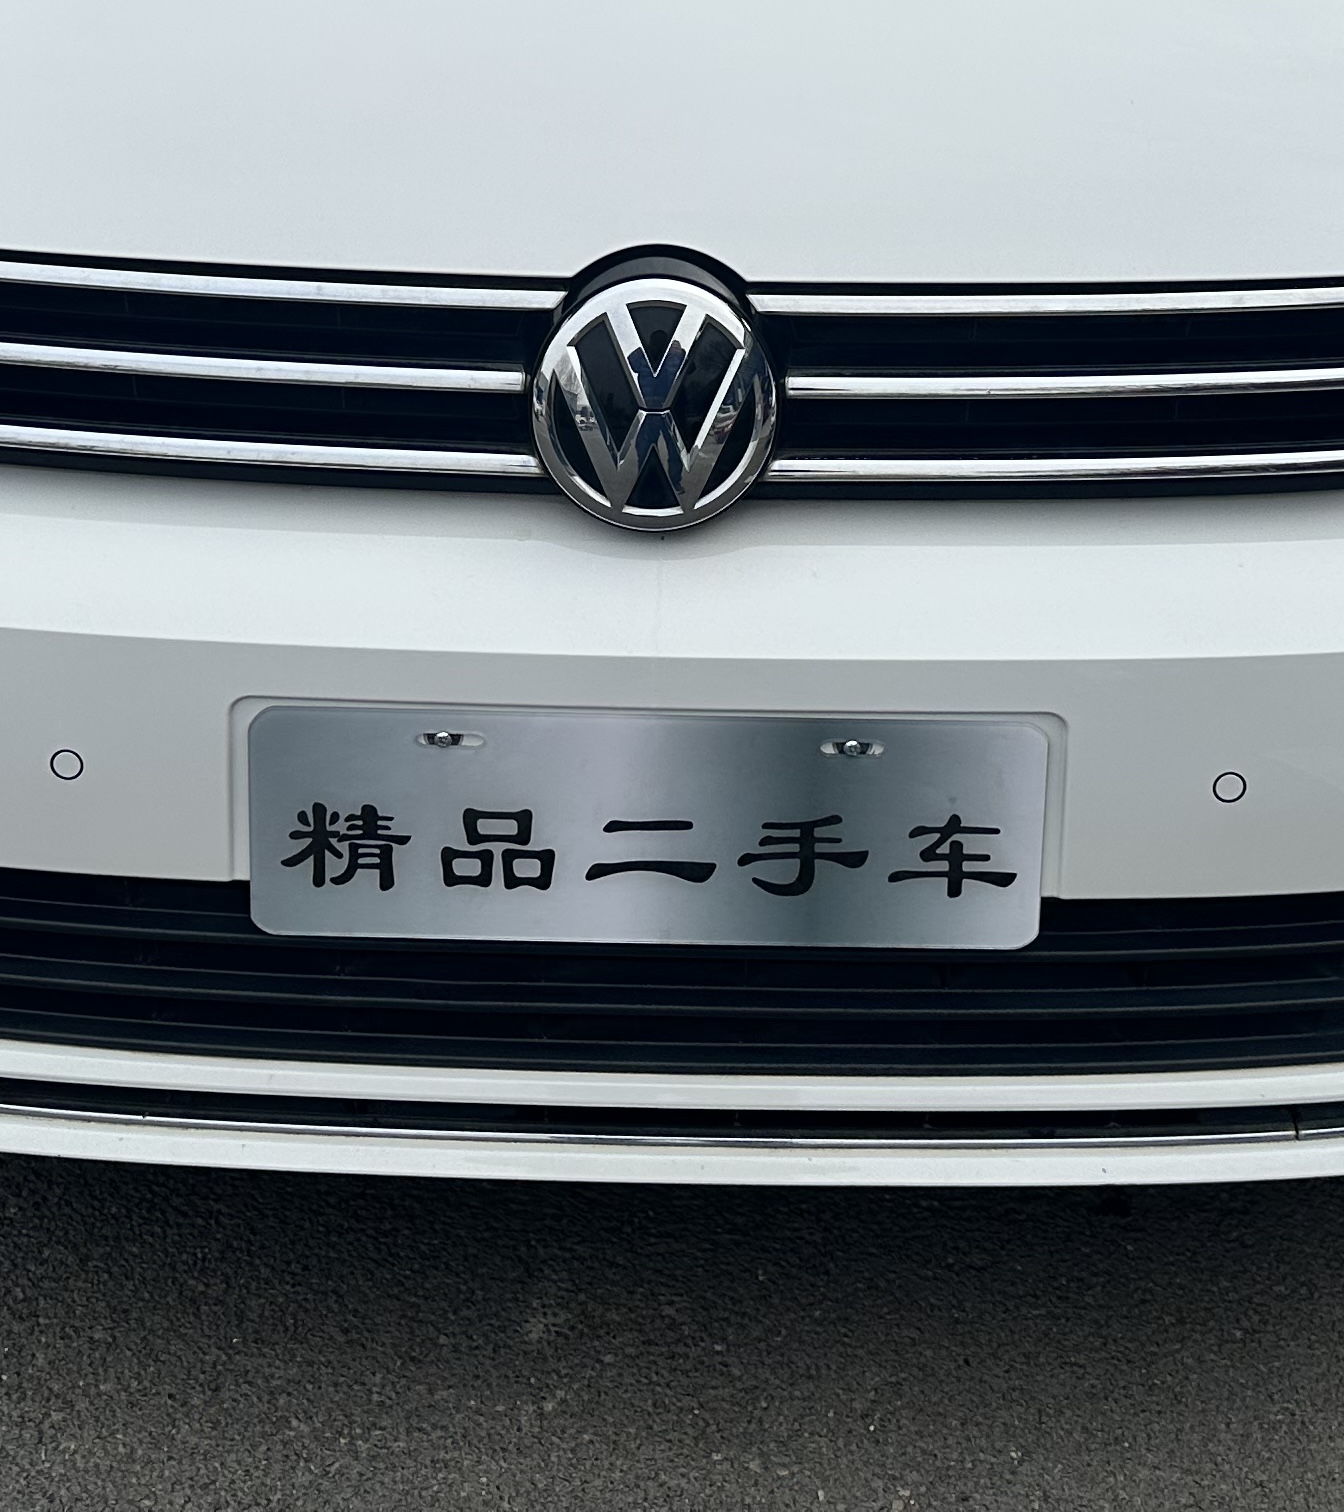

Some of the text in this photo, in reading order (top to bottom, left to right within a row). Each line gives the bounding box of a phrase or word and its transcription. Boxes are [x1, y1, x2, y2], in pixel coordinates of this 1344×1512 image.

[281, 800, 1017, 899] 精品二手车
